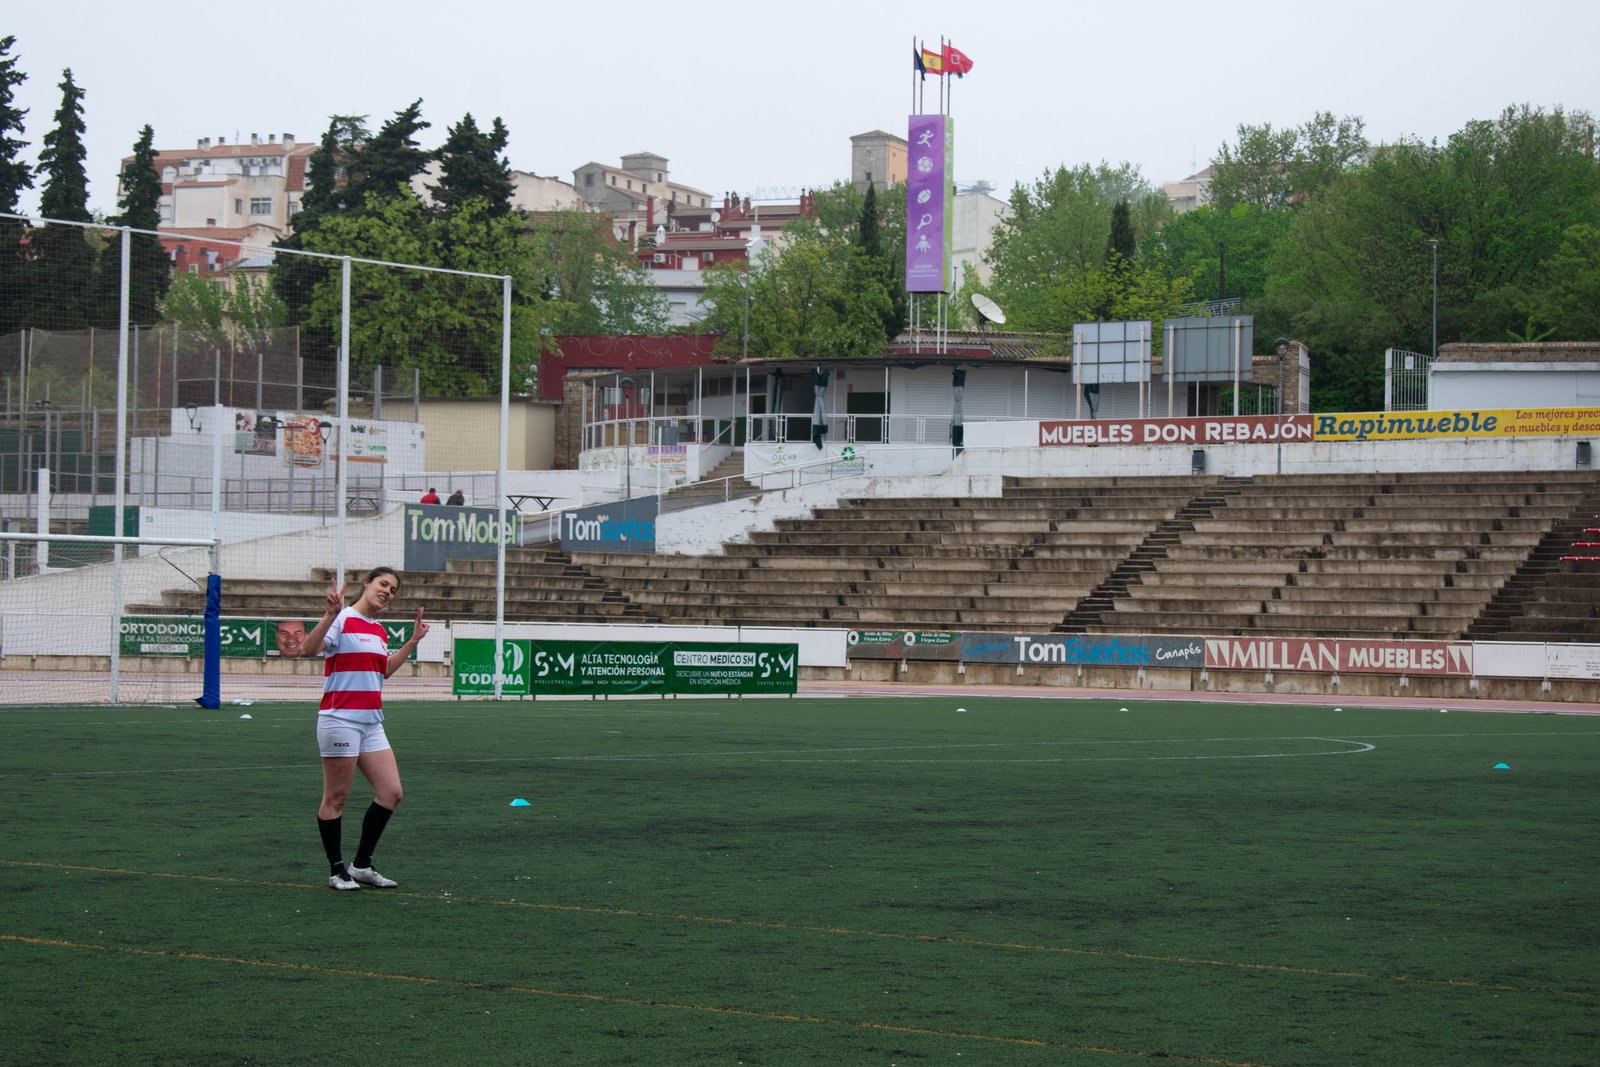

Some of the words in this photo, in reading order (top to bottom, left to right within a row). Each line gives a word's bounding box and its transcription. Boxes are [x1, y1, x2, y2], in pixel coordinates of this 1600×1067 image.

[1515, 410, 1532, 420] Los
[1535, 410, 1575, 422] mejores
[1041, 423, 1133, 444] MUEBLES
[1143, 423, 1196, 442] DON
[1205, 415, 1311, 440] REBAJÓN
[1315, 412, 1497, 439] Rapimueble
[1521, 421, 1561, 433] muebles
[1563, 424, 1569, 434] y
[772, 453, 797, 461] OSCAR
[408, 509, 455, 543] Tom
[458, 511, 517, 544] Mobel
[137, 635, 155, 643] ALTA
[1155, 642, 1201, 660] Canapés
[1230, 641, 1340, 670] MILLAN
[581, 654, 602, 664] ALTA
[604, 652, 659, 664] TECNOLOGÍA
[676, 653, 708, 664] CENTRO
[742, 654, 754, 664] SM
[1348, 647, 1446, 670] MUEBLES
[459, 662, 491, 673] Centro
[581, 667, 586, 675] Y
[587, 665, 626, 675] ATENCIÓN
[627, 667, 665, 675] PERSONAL
[728, 669, 754, 678] ESTÁNDAR
